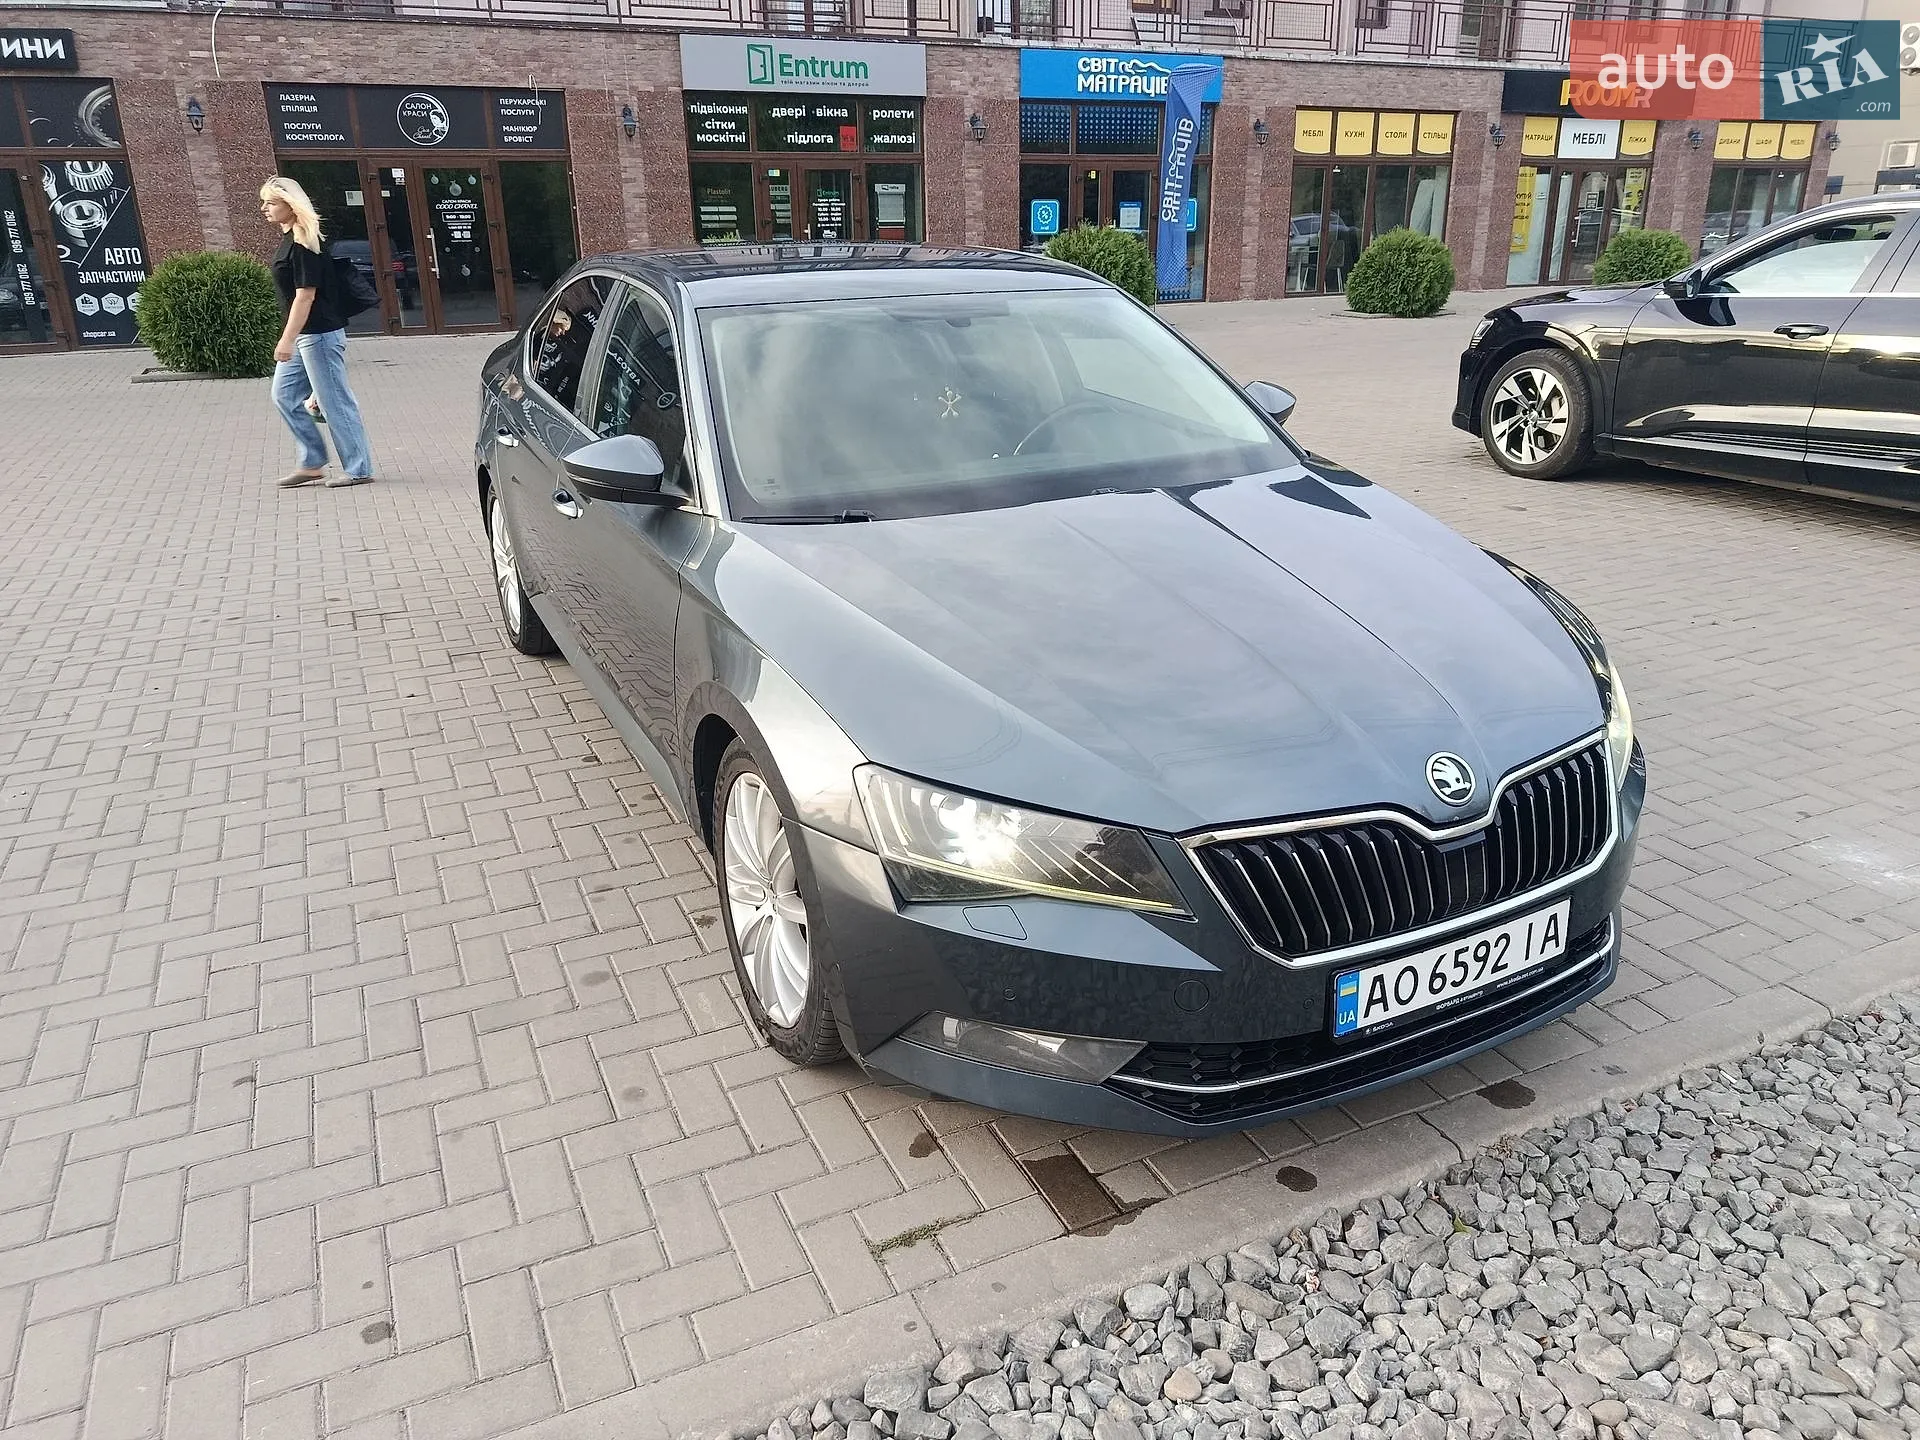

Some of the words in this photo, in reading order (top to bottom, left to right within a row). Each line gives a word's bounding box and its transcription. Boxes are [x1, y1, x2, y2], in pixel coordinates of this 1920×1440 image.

[0, 37, 66, 59] ИНИ
[779, 54, 869, 79] Entrum
[1077, 56, 1120, 73] СВІТ
[405, 102, 432, 110] САЛОН
[499, 98, 547, 106] ПЕРУКАРСЬКІ
[500, 108, 535, 116] ПОСЛУГИ
[690, 103, 748, 115] підвіконня
[771, 105, 806, 117] двері
[815, 106, 849, 118] вікна
[872, 109, 915, 120] ролети
[283, 122, 322, 130] ПОСЛУГИ
[704, 120, 736, 130] сітки
[285, 133, 345, 141] КОСМЕТОЛОГА
[503, 135, 534, 143] БРОВІСТ
[696, 132, 746, 143] москітні
[786, 132, 834, 145] підлога
[873, 133, 917, 144] жалюзі
[1302, 129, 1324, 137] МЕБЛІ
[1344, 130, 1365, 138] КУХНІ
[1384, 131, 1408, 139] СТОЛИ
[1422, 132, 1448, 140] СТІЛЬЦІ
[1524, 133, 1554, 142] МАТРАЦИ
[1572, 132, 1607, 145] МЕБЛІ
[1162, 178, 1175, 222] СВІТ
[8, 227, 20, 240] 777
[12, 240, 23, 254] 096
[104, 247, 142, 265] АВТО
[78, 270, 146, 284] ЗАПЧАСТИНИ
[21, 280, 32, 292] 777
[24, 292, 36, 305] 099
[1363, 965, 1419, 1018] AO
[1428, 932, 1511, 996] 6592
[1525, 912, 1561, 961] IA
[1339, 1009, 1356, 1025] UA
